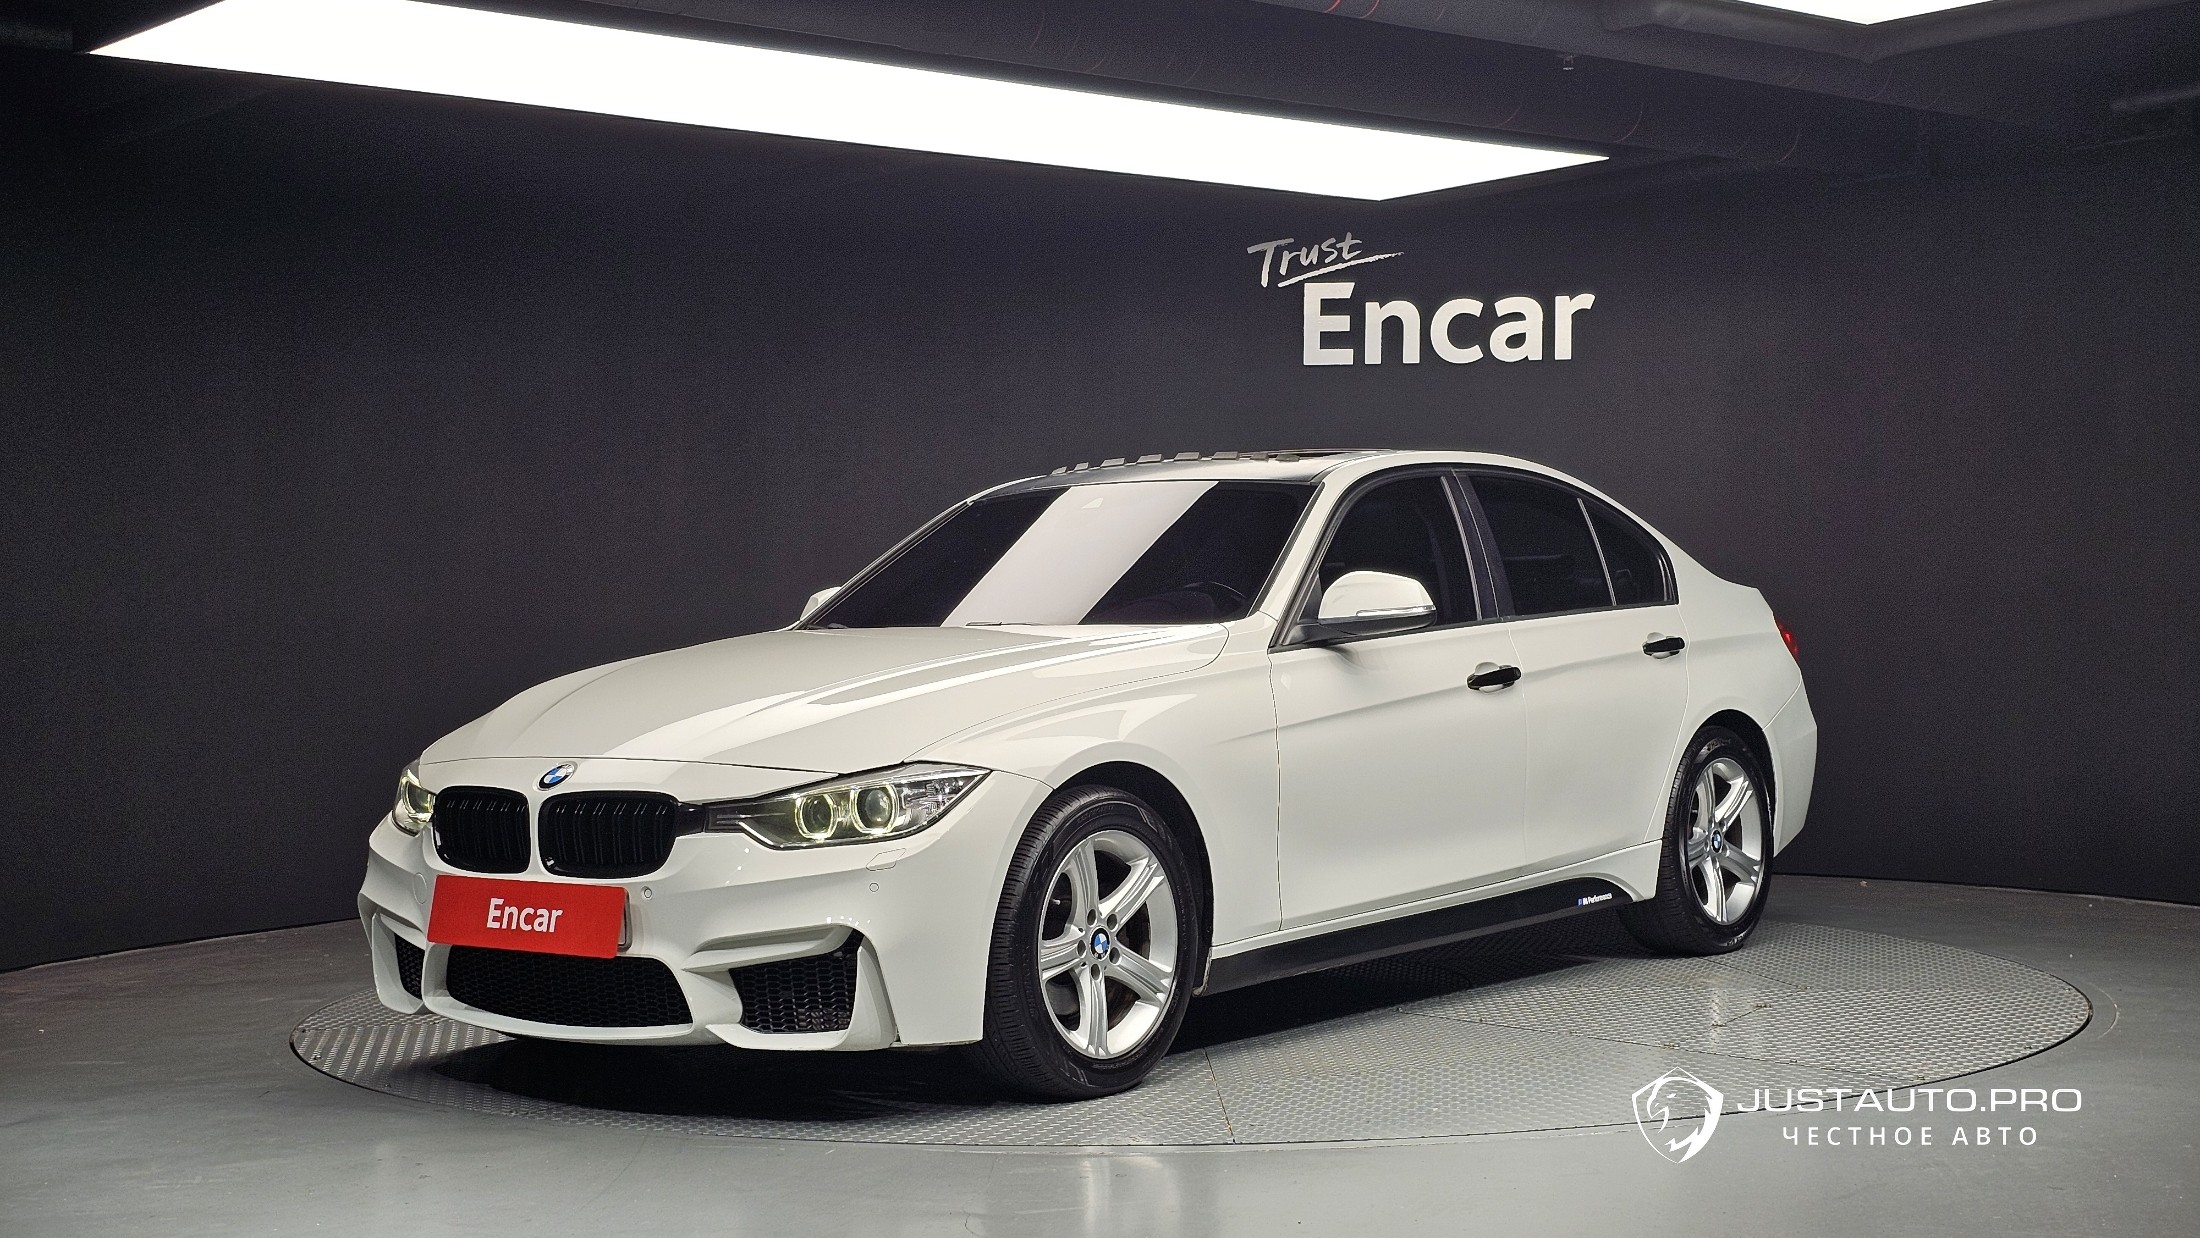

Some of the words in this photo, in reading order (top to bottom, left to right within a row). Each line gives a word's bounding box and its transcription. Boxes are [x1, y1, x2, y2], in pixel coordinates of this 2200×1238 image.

[1247, 232, 1363, 288] Trust
[1303, 282, 1596, 366] Encar
[486, 897, 563, 933] Encar
